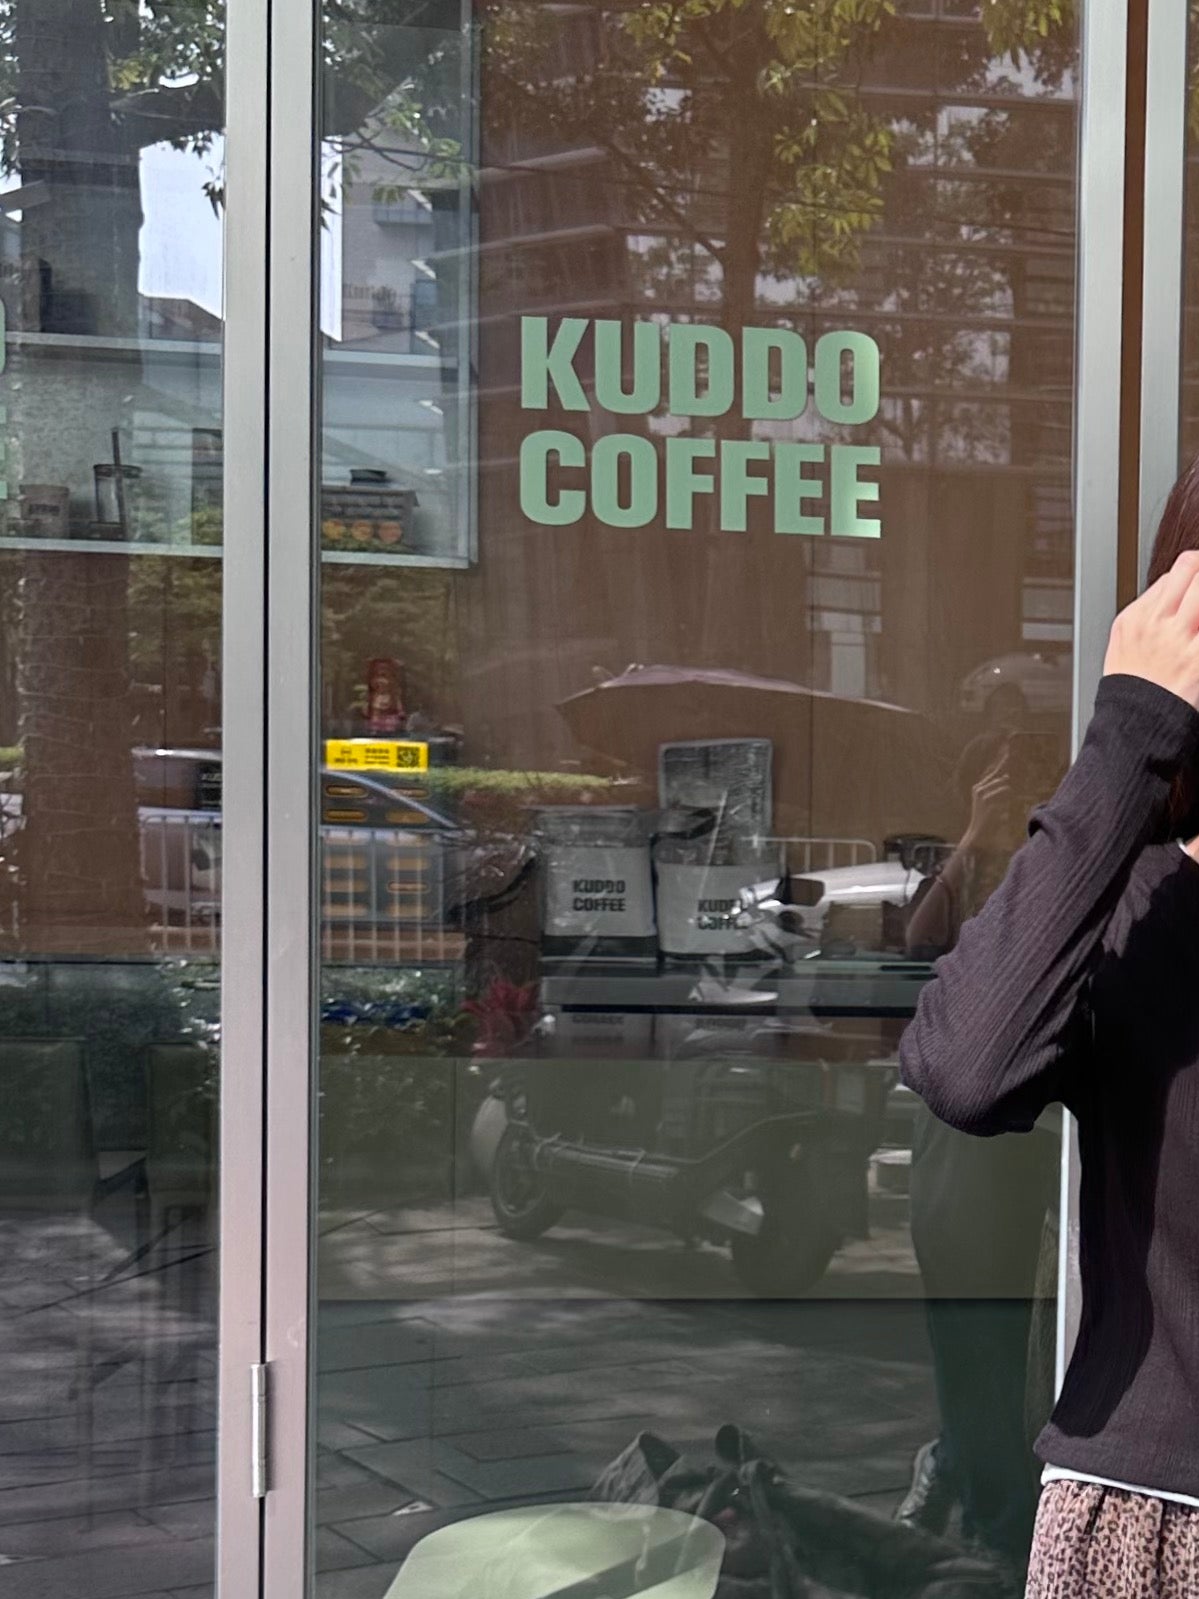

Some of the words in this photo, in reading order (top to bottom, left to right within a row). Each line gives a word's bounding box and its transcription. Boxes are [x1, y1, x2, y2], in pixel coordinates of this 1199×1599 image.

[520, 316, 881, 426] KUDDO
[519, 429, 882, 538] COFFEE
[572, 879, 626, 894] KUDDO
[572, 897, 626, 912] COFFEE
